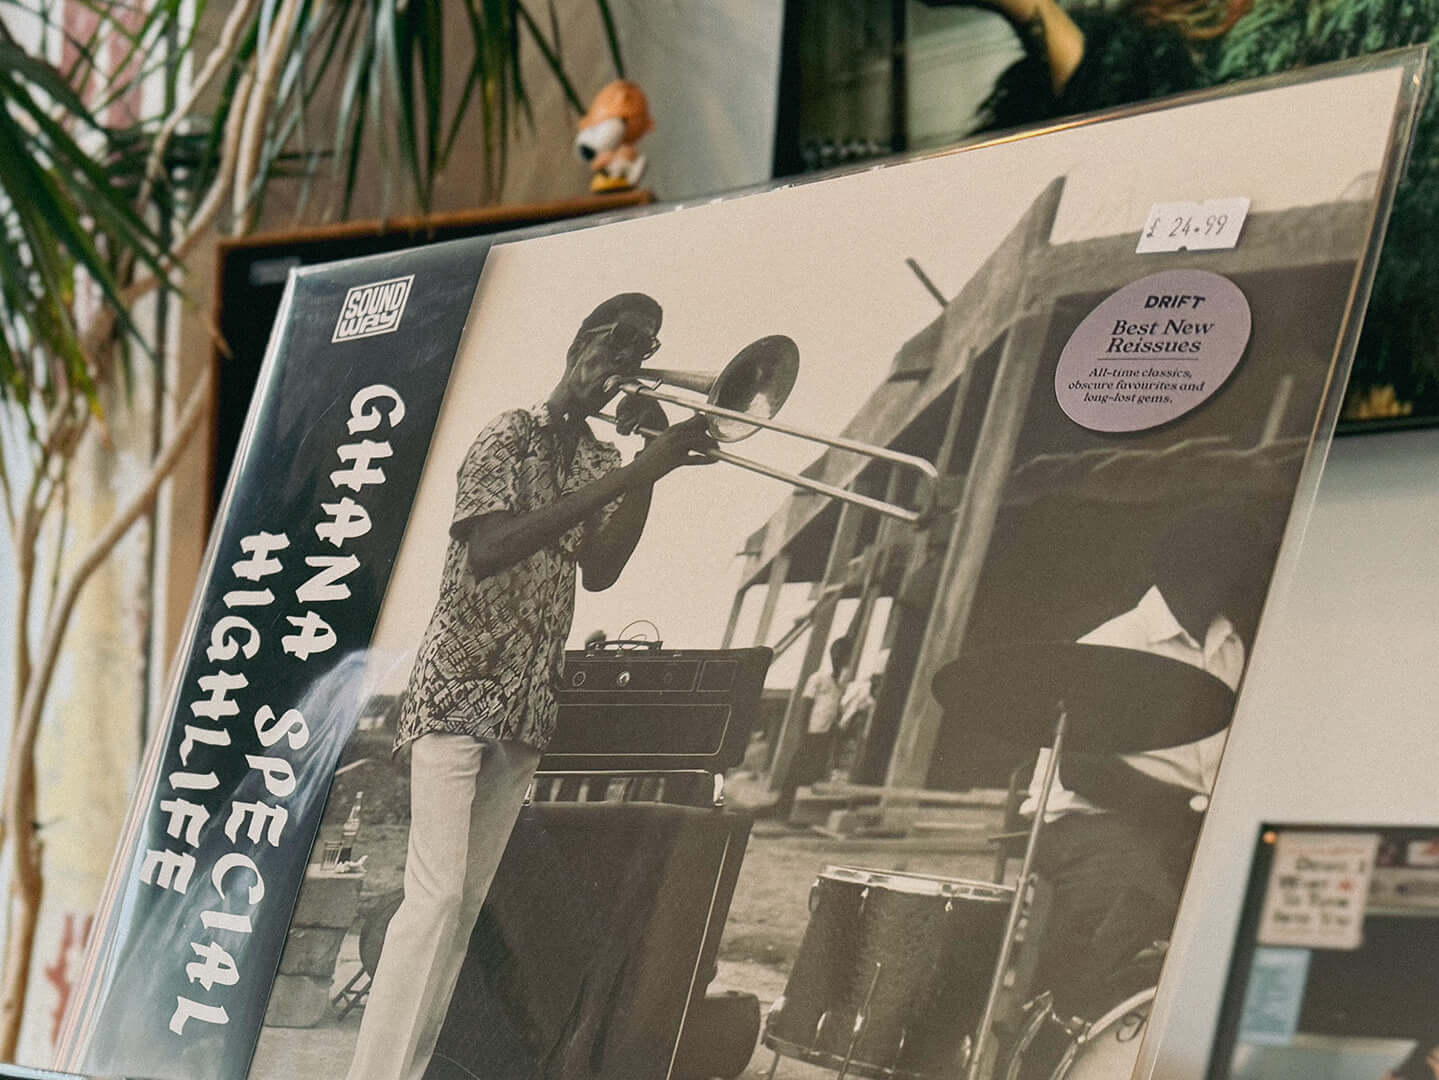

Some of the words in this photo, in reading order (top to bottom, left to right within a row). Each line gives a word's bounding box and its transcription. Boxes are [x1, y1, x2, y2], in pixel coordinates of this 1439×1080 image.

[1168, 213, 1228, 238] 24.99
[344, 281, 407, 319] SOUND
[1143, 294, 1207, 310] DRIFT
[338, 309, 399, 337] WAY
[1111, 319, 1160, 336] Best
[1161, 318, 1216, 336] New
[1105, 336, 1202, 354] Reissues
[1088, 367, 1141, 378] All-time
[1141, 367, 1193, 379] classics,
[1067, 379, 1114, 390] obscure
[1115, 380, 1178, 391] favourites
[1179, 381, 1206, 392] and
[1083, 391, 1137, 404] long-lost
[280, 384, 406, 661] GHANA
[139, 531, 290, 895] HIGHLIFE
[168, 704, 310, 1036] SPECIAL
